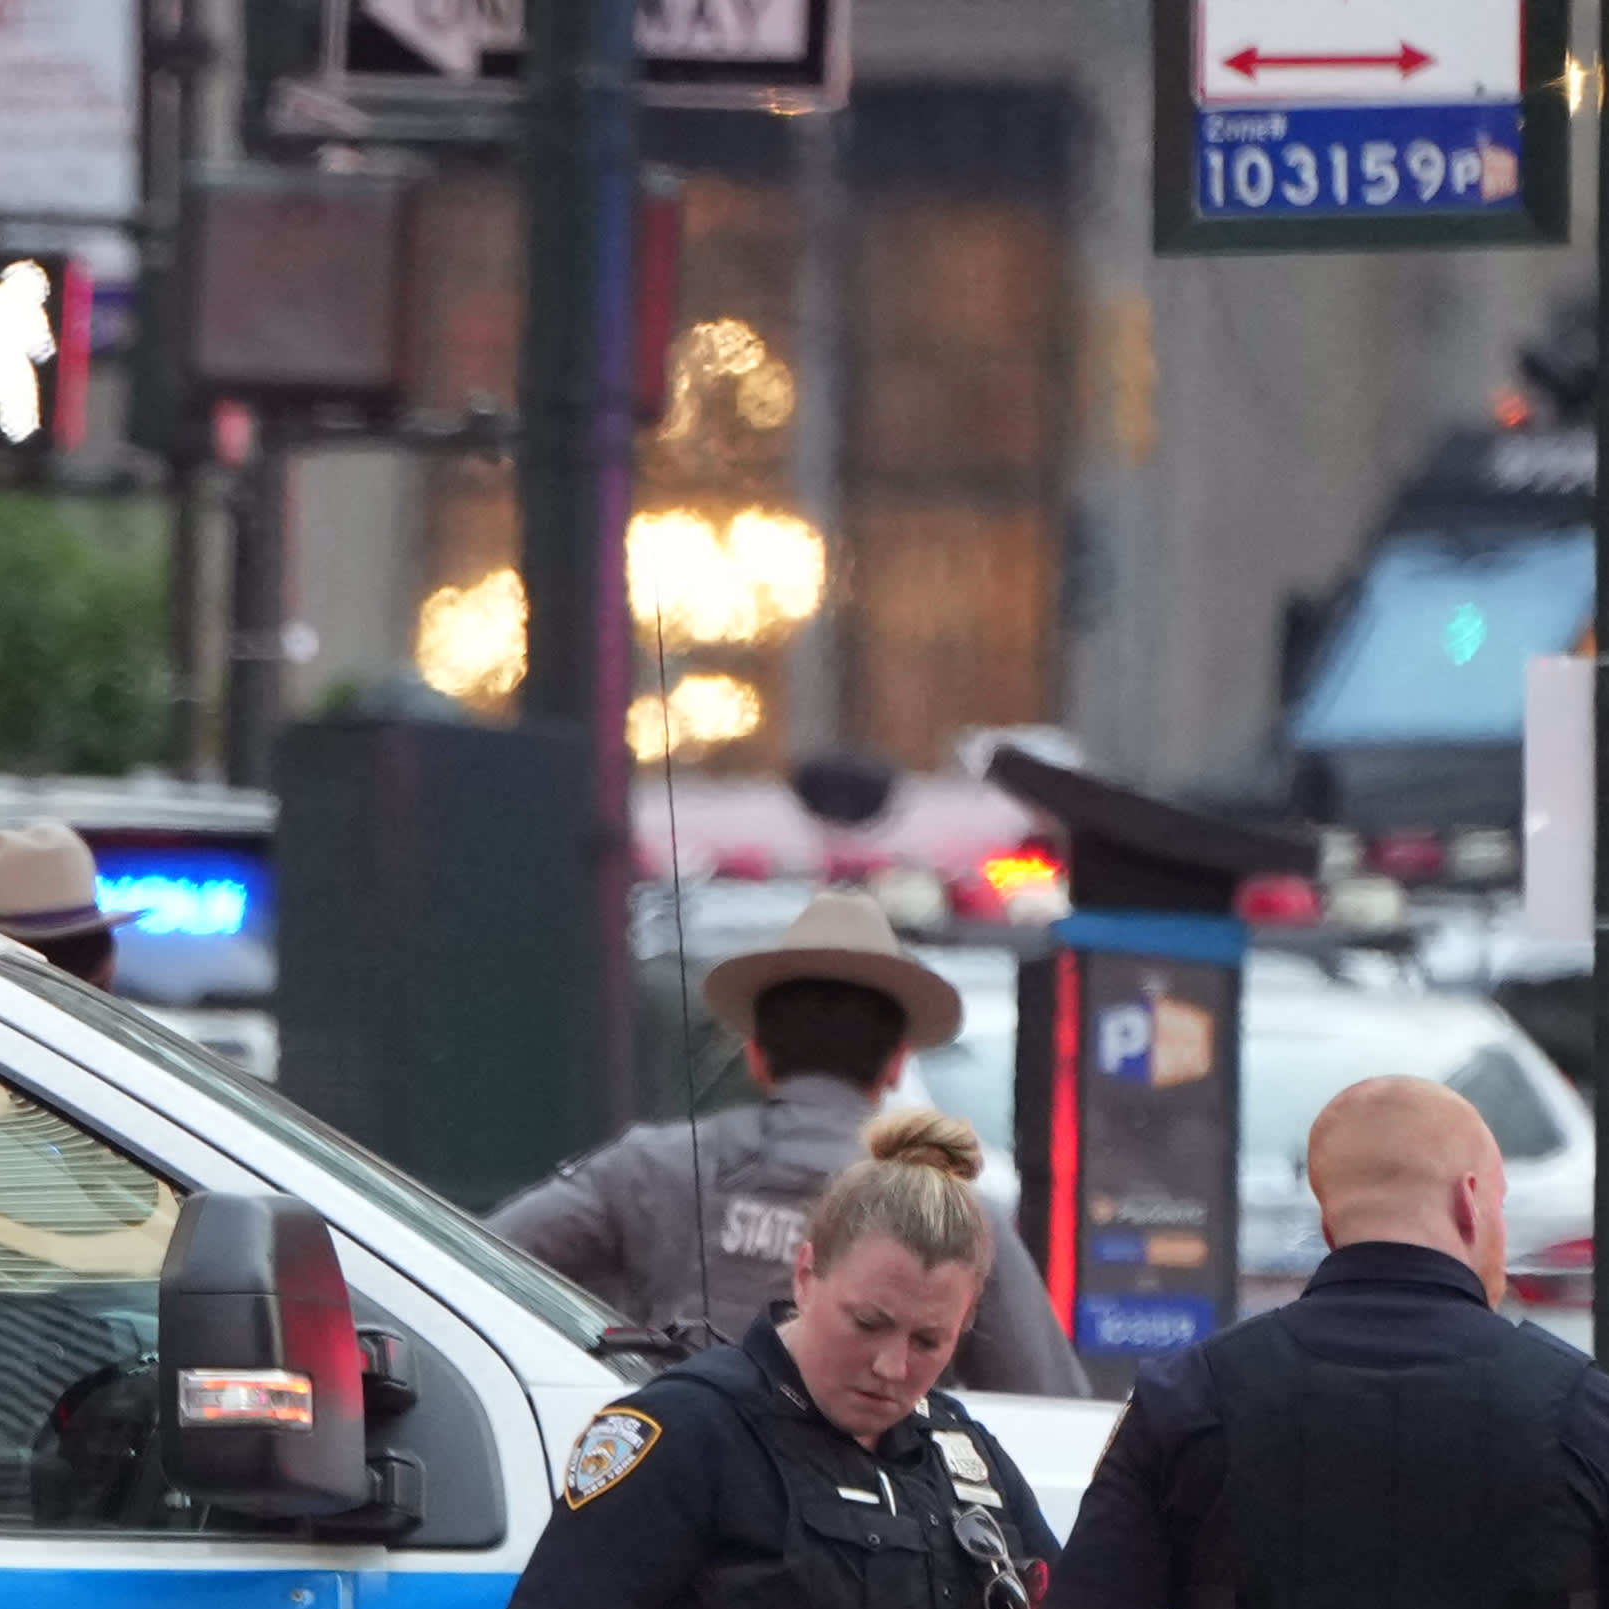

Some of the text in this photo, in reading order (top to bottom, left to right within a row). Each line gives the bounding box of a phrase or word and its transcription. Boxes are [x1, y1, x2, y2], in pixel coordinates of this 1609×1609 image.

[1203, 140, 1446, 207] 103159
[1099, 1009, 1151, 1075] P
[720, 1199, 805, 1265] STATE
